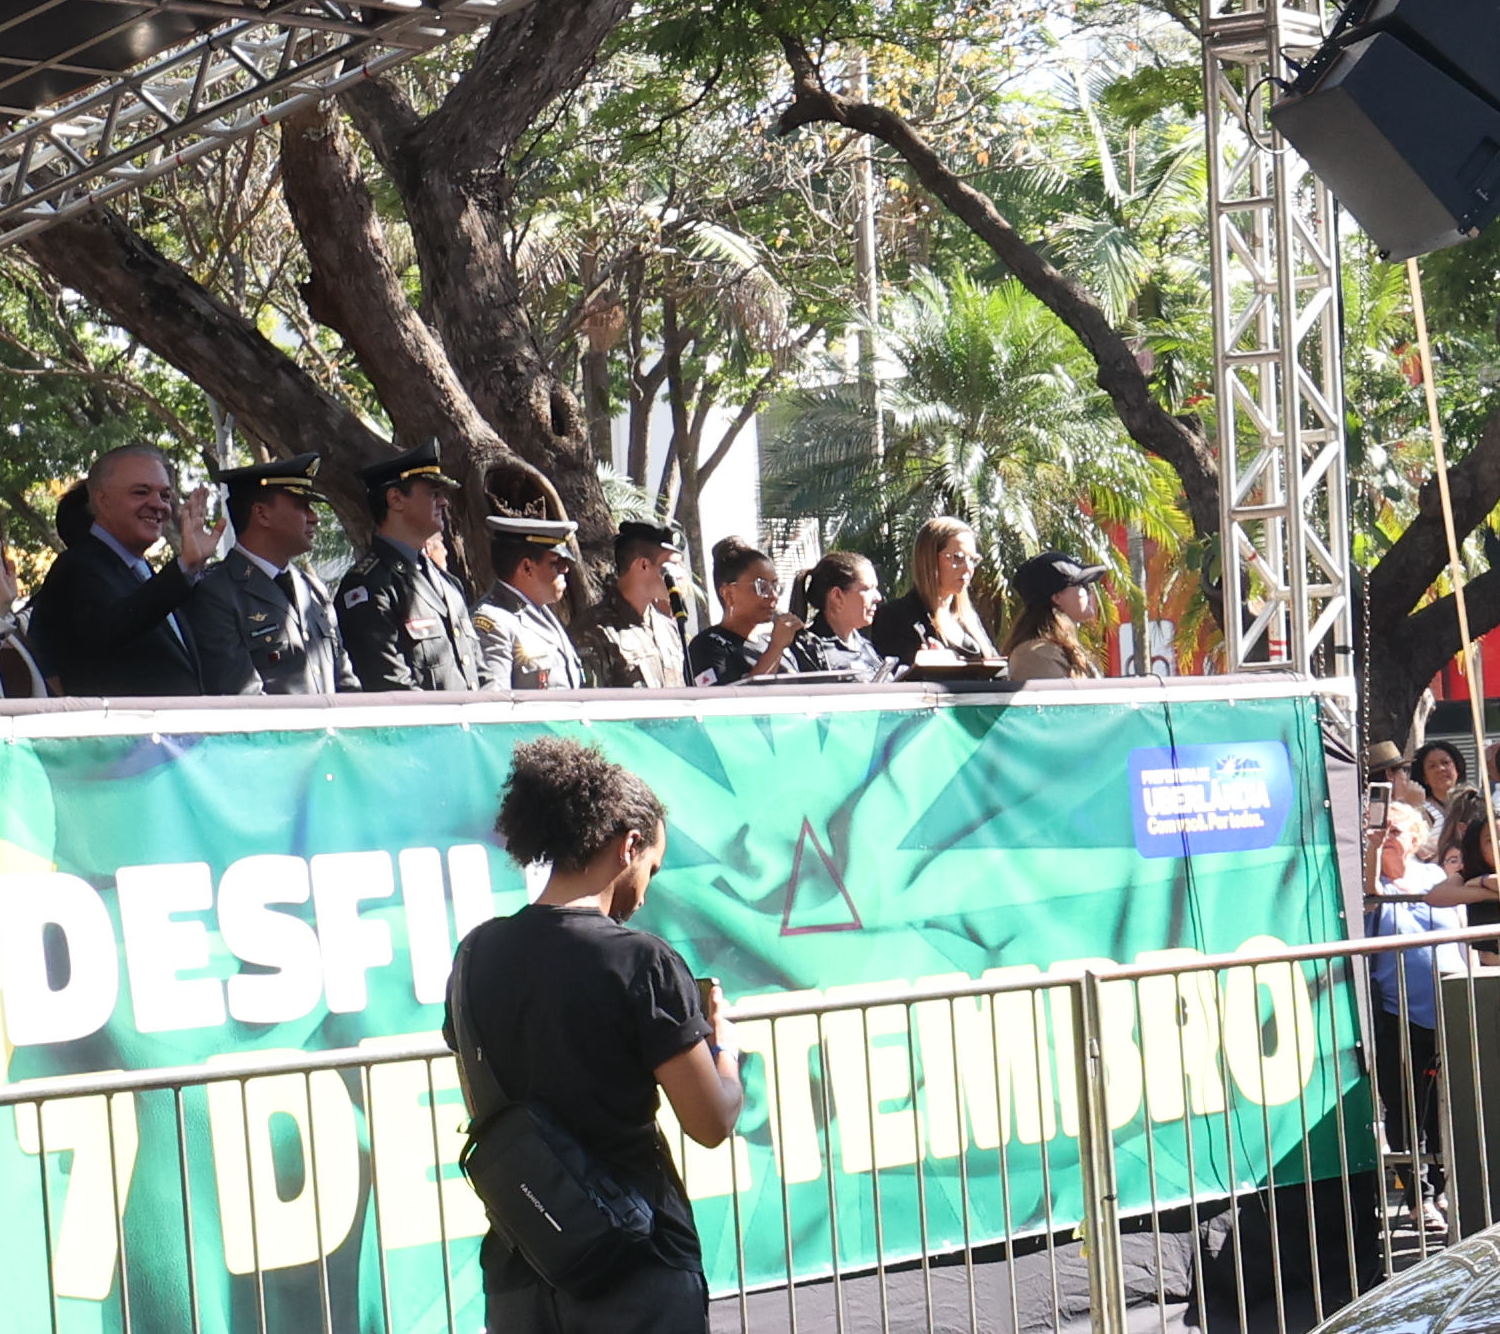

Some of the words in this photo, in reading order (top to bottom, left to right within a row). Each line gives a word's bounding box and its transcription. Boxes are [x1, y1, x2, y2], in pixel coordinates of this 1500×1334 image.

[14, 1069, 141, 1301] 7
[206, 1030, 491, 1275] DE
[655, 935, 1316, 1200] TEMBRO
[520, 1183, 545, 1213] FASHION
